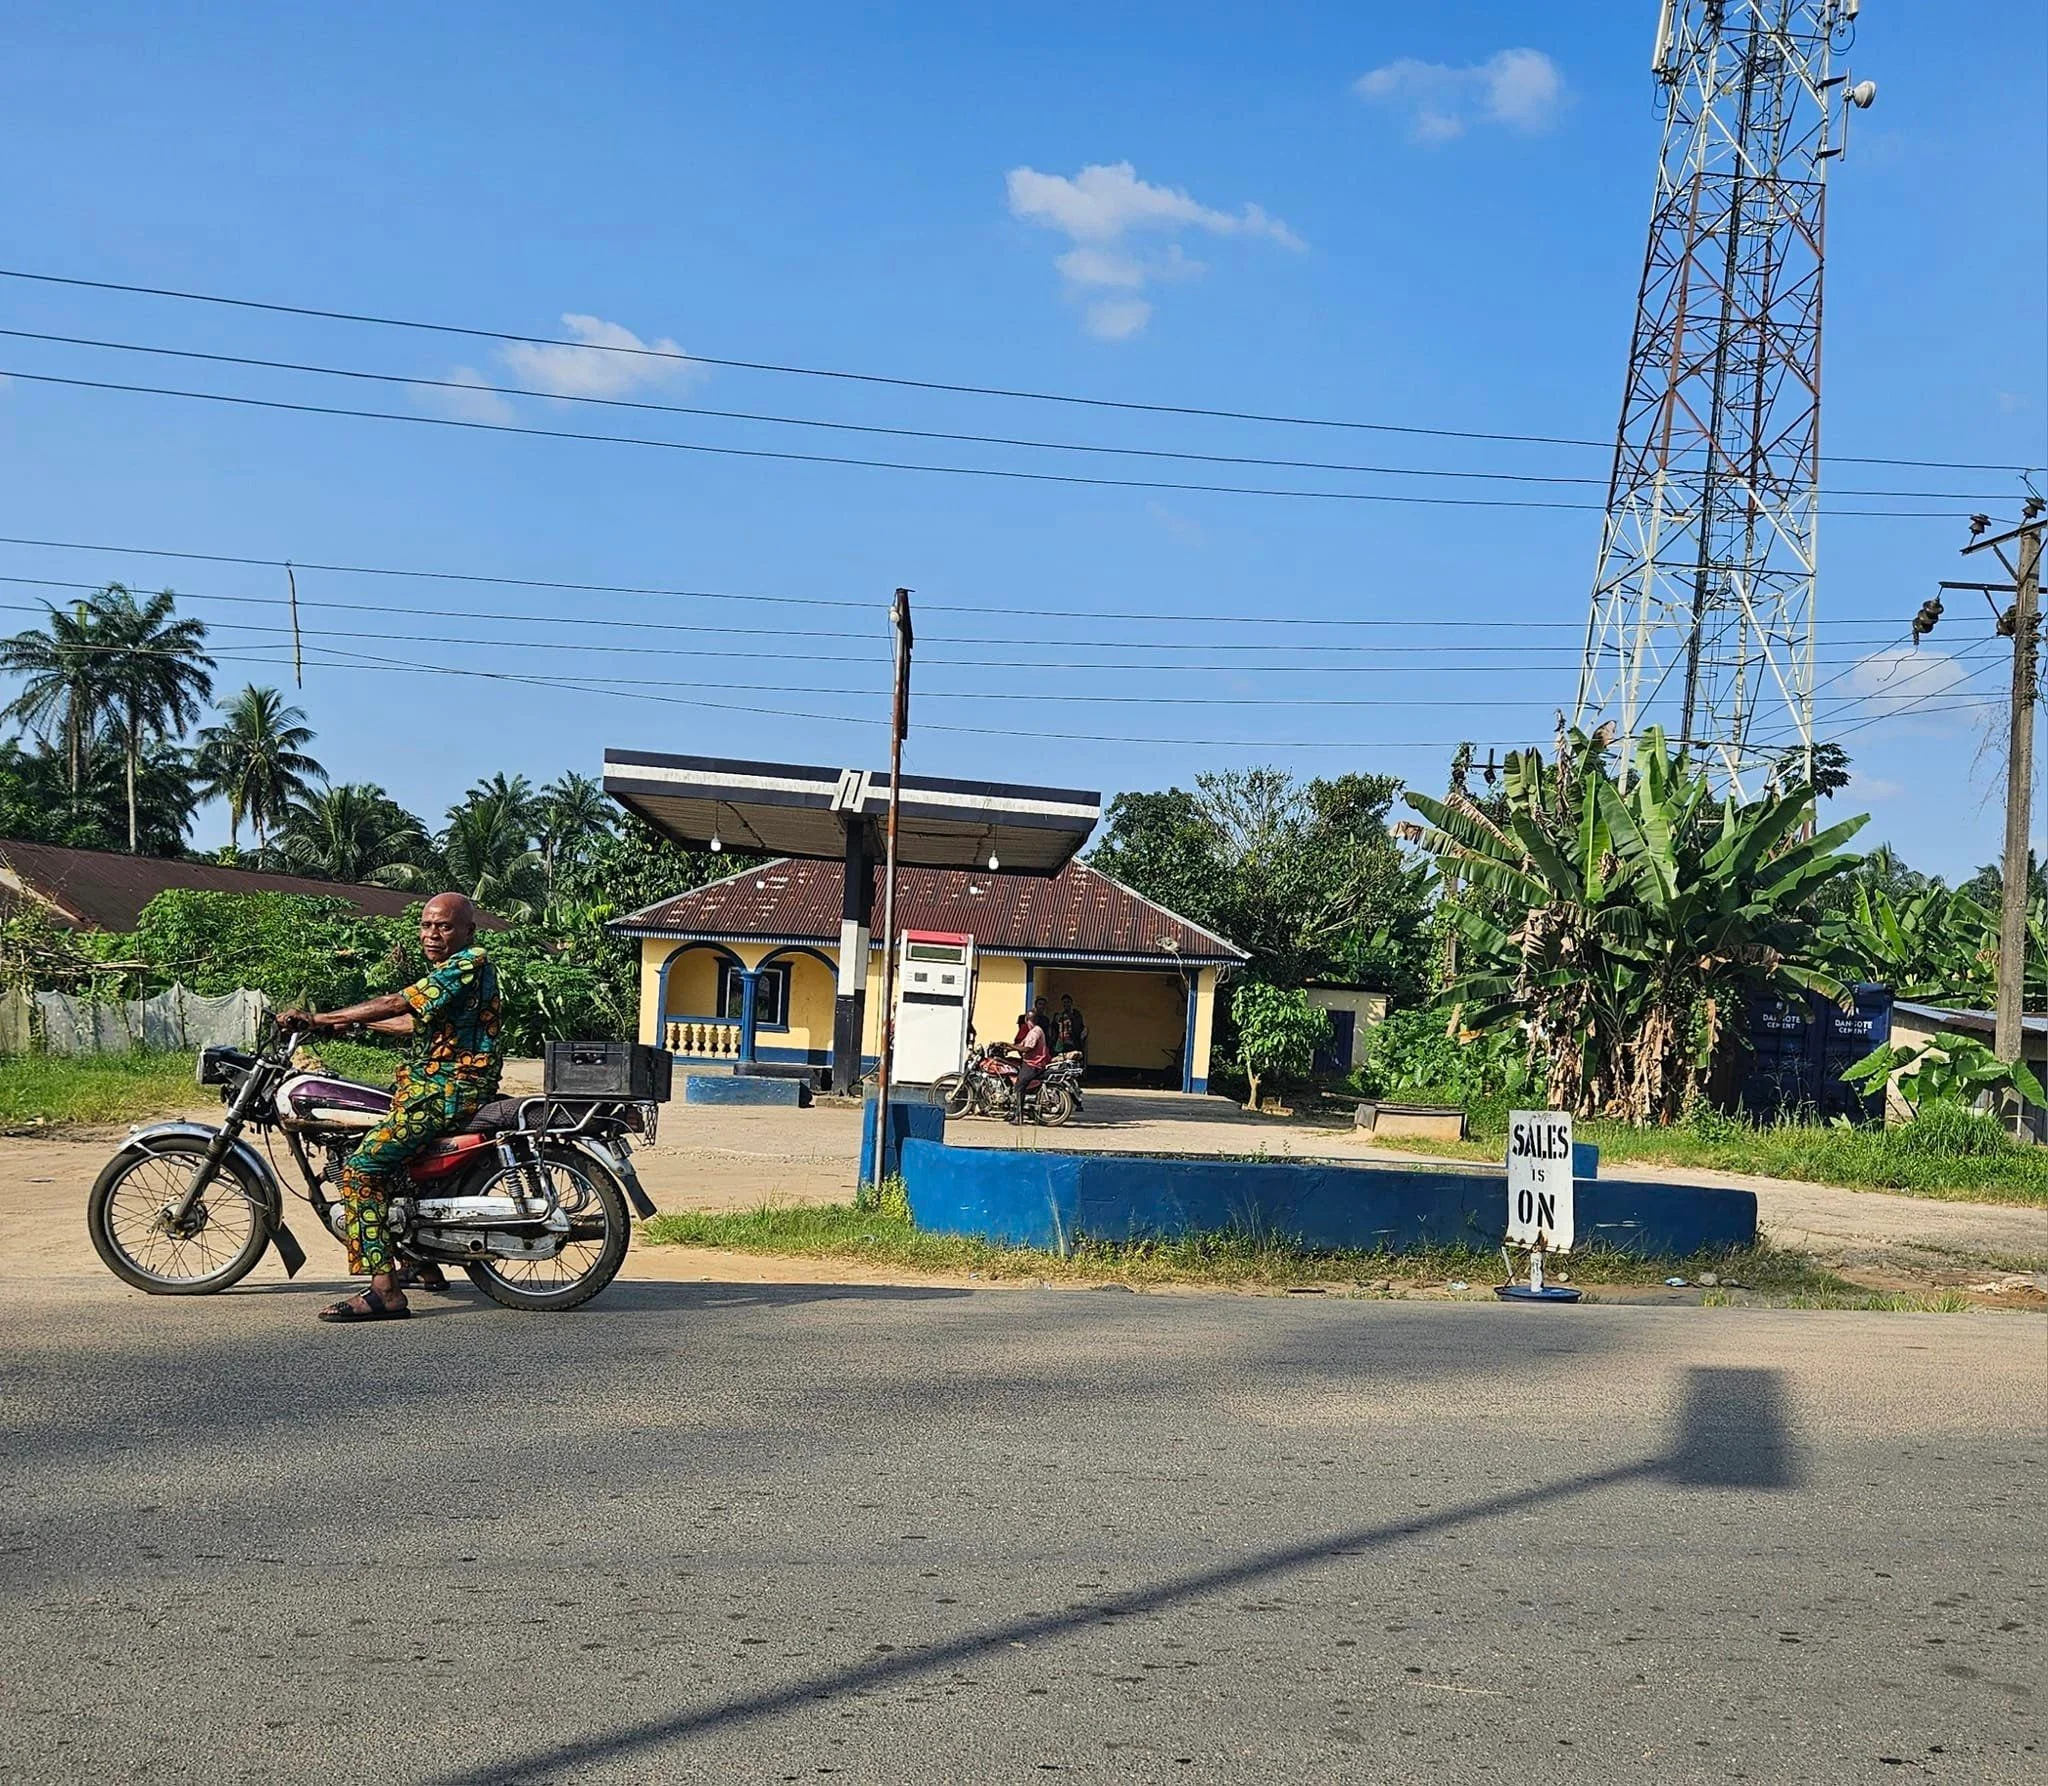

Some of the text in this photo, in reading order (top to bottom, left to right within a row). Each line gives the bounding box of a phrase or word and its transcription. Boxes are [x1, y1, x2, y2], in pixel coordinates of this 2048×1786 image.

[1762, 1013, 1801, 1024] DAOTE
[1512, 1124, 1569, 1159] SALES
[1532, 1169, 1545, 1182] IS
[1518, 1189, 1555, 1230] ON
